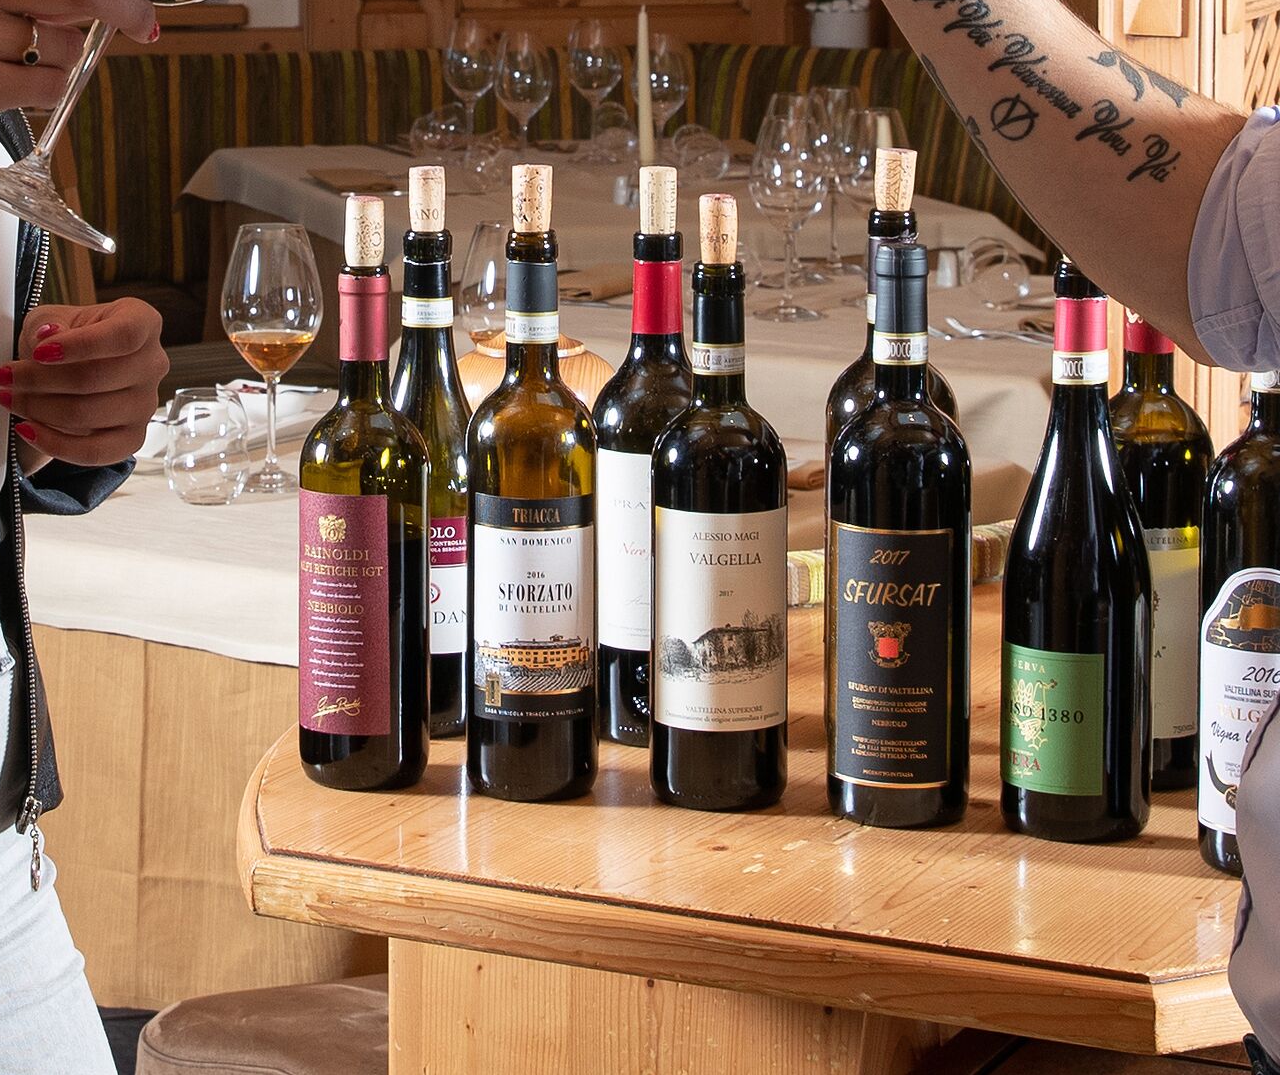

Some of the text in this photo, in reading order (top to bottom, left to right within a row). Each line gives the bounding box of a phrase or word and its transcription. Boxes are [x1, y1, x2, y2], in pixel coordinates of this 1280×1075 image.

[512, 507, 561, 523] TRIACCA
[500, 536, 572, 547] SAN DOMENICO
[692, 531, 760, 541] ALESSIO MAGI
[304, 543, 369, 561] RAINOLDI
[689, 551, 762, 566] VALGELLA
[869, 549, 910, 565] 2017
[362, 565, 384, 577] IGT
[526, 571, 546, 579] 2016
[498, 582, 573, 603] SFORZATO
[843, 577, 942, 608] SFURSAT
[307, 599, 365, 615] NEBBIOLO
[513, 604, 573, 614] VALTELLINA
[1040, 707, 1084, 724] 1380
